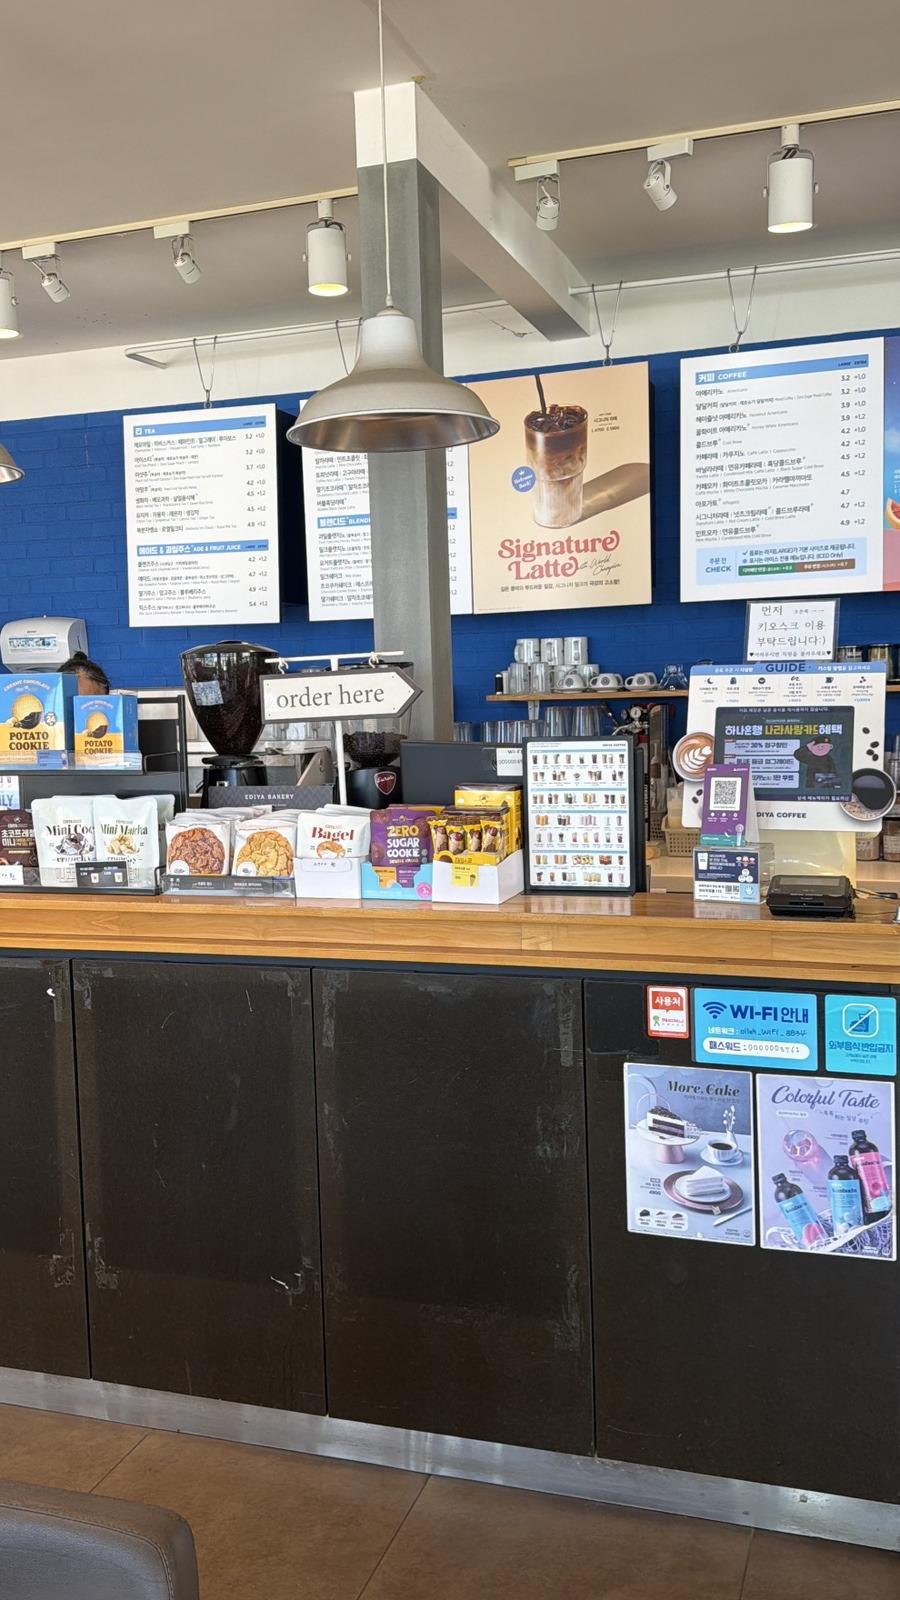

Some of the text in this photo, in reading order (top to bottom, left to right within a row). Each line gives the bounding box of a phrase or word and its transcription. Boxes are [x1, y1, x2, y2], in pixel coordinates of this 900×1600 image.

[699, 373, 715, 383] 커피
[718, 371, 747, 381] COFFEE
[695, 389, 723, 397] 아메리카노
[135, 428, 142, 436] 티
[319, 517, 371, 527] 블렌디드 BLEND
[139, 547, 158, 555] 에이드
[165, 545, 191, 554] 과일주스
[498, 530, 621, 563] Signature
[709, 557, 720, 565] 주문
[507, 556, 579, 581] Latte
[705, 565, 732, 574] CHECK
[761, 605, 783, 616] 먼저
[758, 620, 826, 632] 키오스크 이용
[765, 662, 806, 673] GUIDE
[277, 684, 385, 708] order here
[9, 731, 49, 741] POTATO
[725, 725, 763, 736] 하나은행
[9, 741, 50, 751] COOKIE
[84, 740, 113, 748] POTATO
[84, 747, 113, 755] COOKIE
[756, 811, 807, 819] DIYA COFFEE
[46, 824, 72, 837] Mini
[311, 826, 355, 842] Bagel
[386, 825, 419, 837] ZERO
[2, 838, 16, 847] 미니
[386, 837, 420, 848] SUGAR
[386, 848, 420, 858] COOKIE
[655, 996, 680, 1007] 사용처
[730, 1004, 809, 1023] WI-FI 안내
[708, 1026, 735, 1036] 네트워크
[709, 1041, 741, 1051] 패스워드
[829, 1040, 894, 1053] 외부음식 반입금지
[706, 1084, 740, 1097] Cake
[771, 1085, 880, 1109] Colorful Taste
